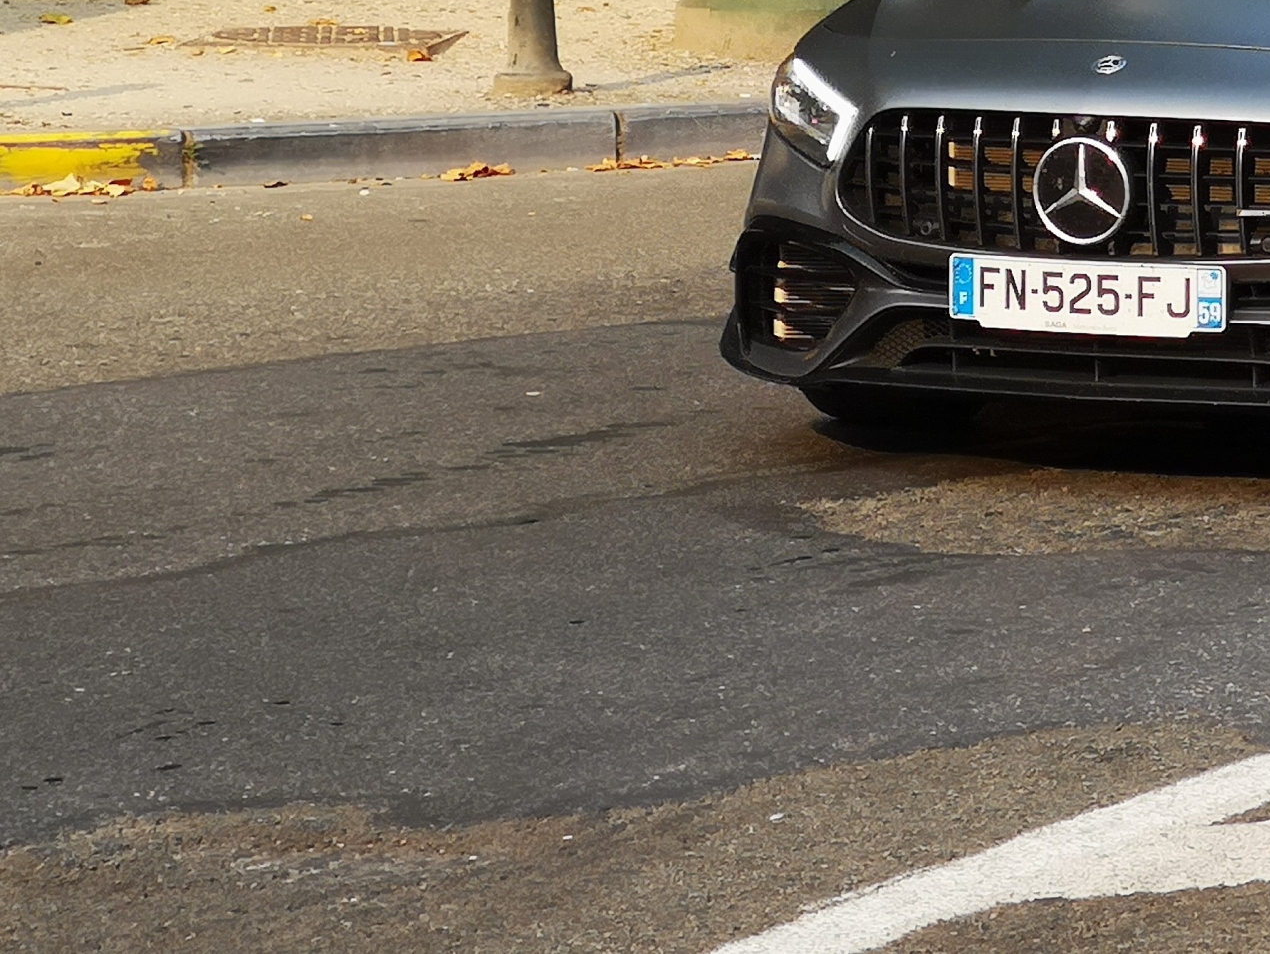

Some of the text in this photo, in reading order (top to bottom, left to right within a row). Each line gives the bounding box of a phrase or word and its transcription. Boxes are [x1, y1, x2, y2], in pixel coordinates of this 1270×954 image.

[959, 291, 968, 305] F
[979, 266, 1191, 318] FN-525-FJ
[1198, 302, 1221, 324] 59
